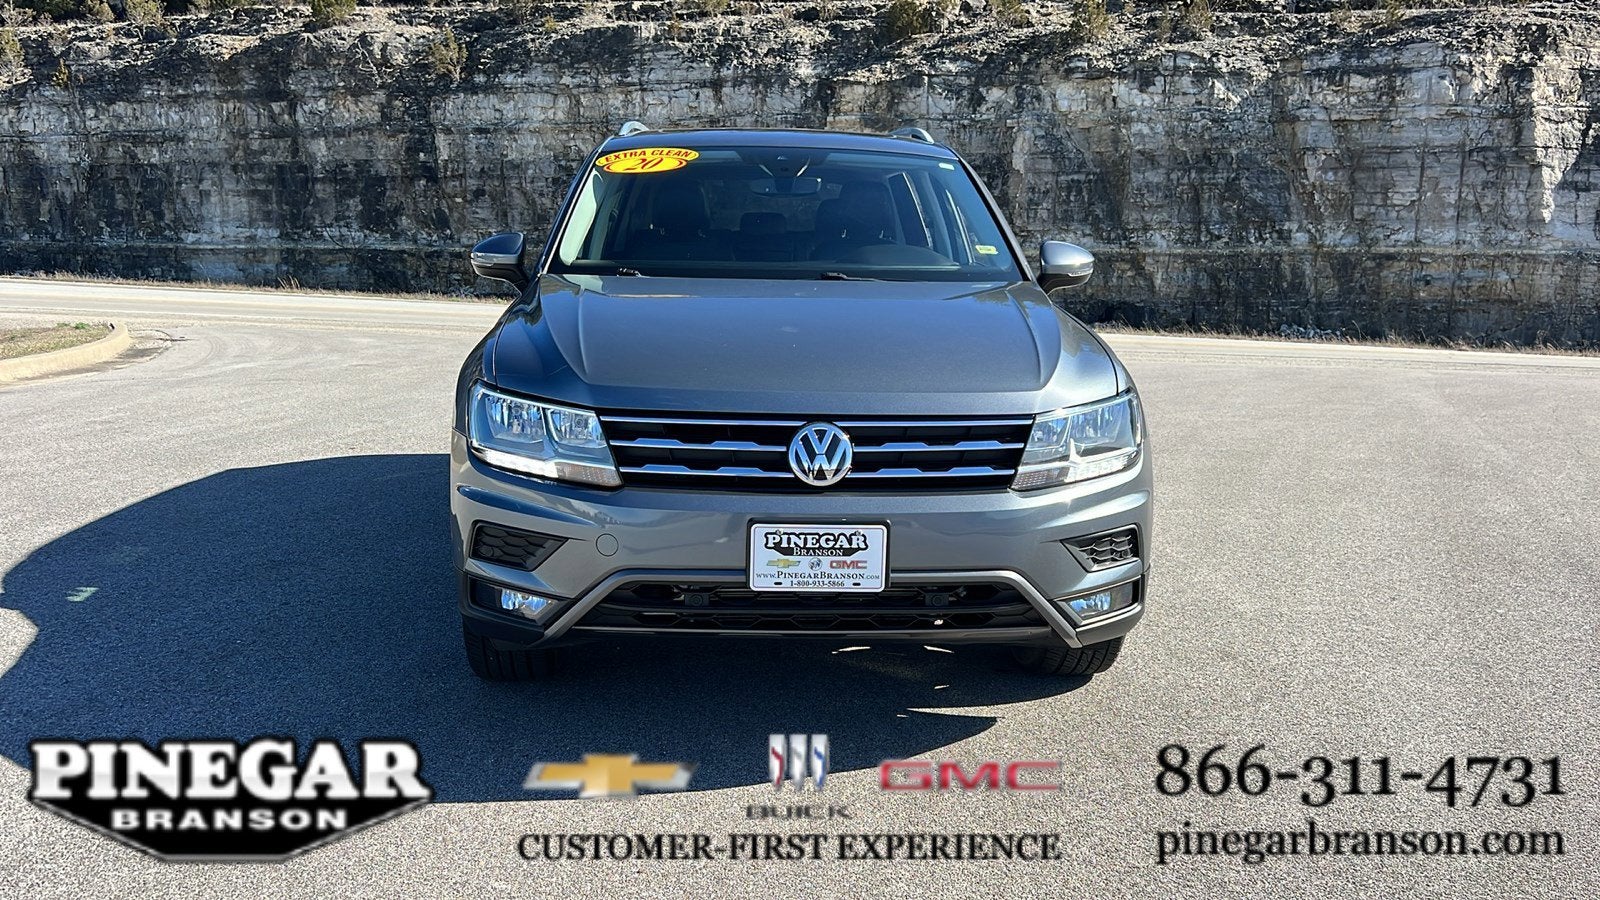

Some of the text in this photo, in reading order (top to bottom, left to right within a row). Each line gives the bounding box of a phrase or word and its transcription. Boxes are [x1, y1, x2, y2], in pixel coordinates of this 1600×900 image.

[605, 149, 692, 162] EXTRA CLEAN
[622, 157, 664, 171] 20
[766, 533, 867, 549] PINEGAR
[793, 547, 844, 556] BRANSON
[829, 560, 867, 569] GMC
